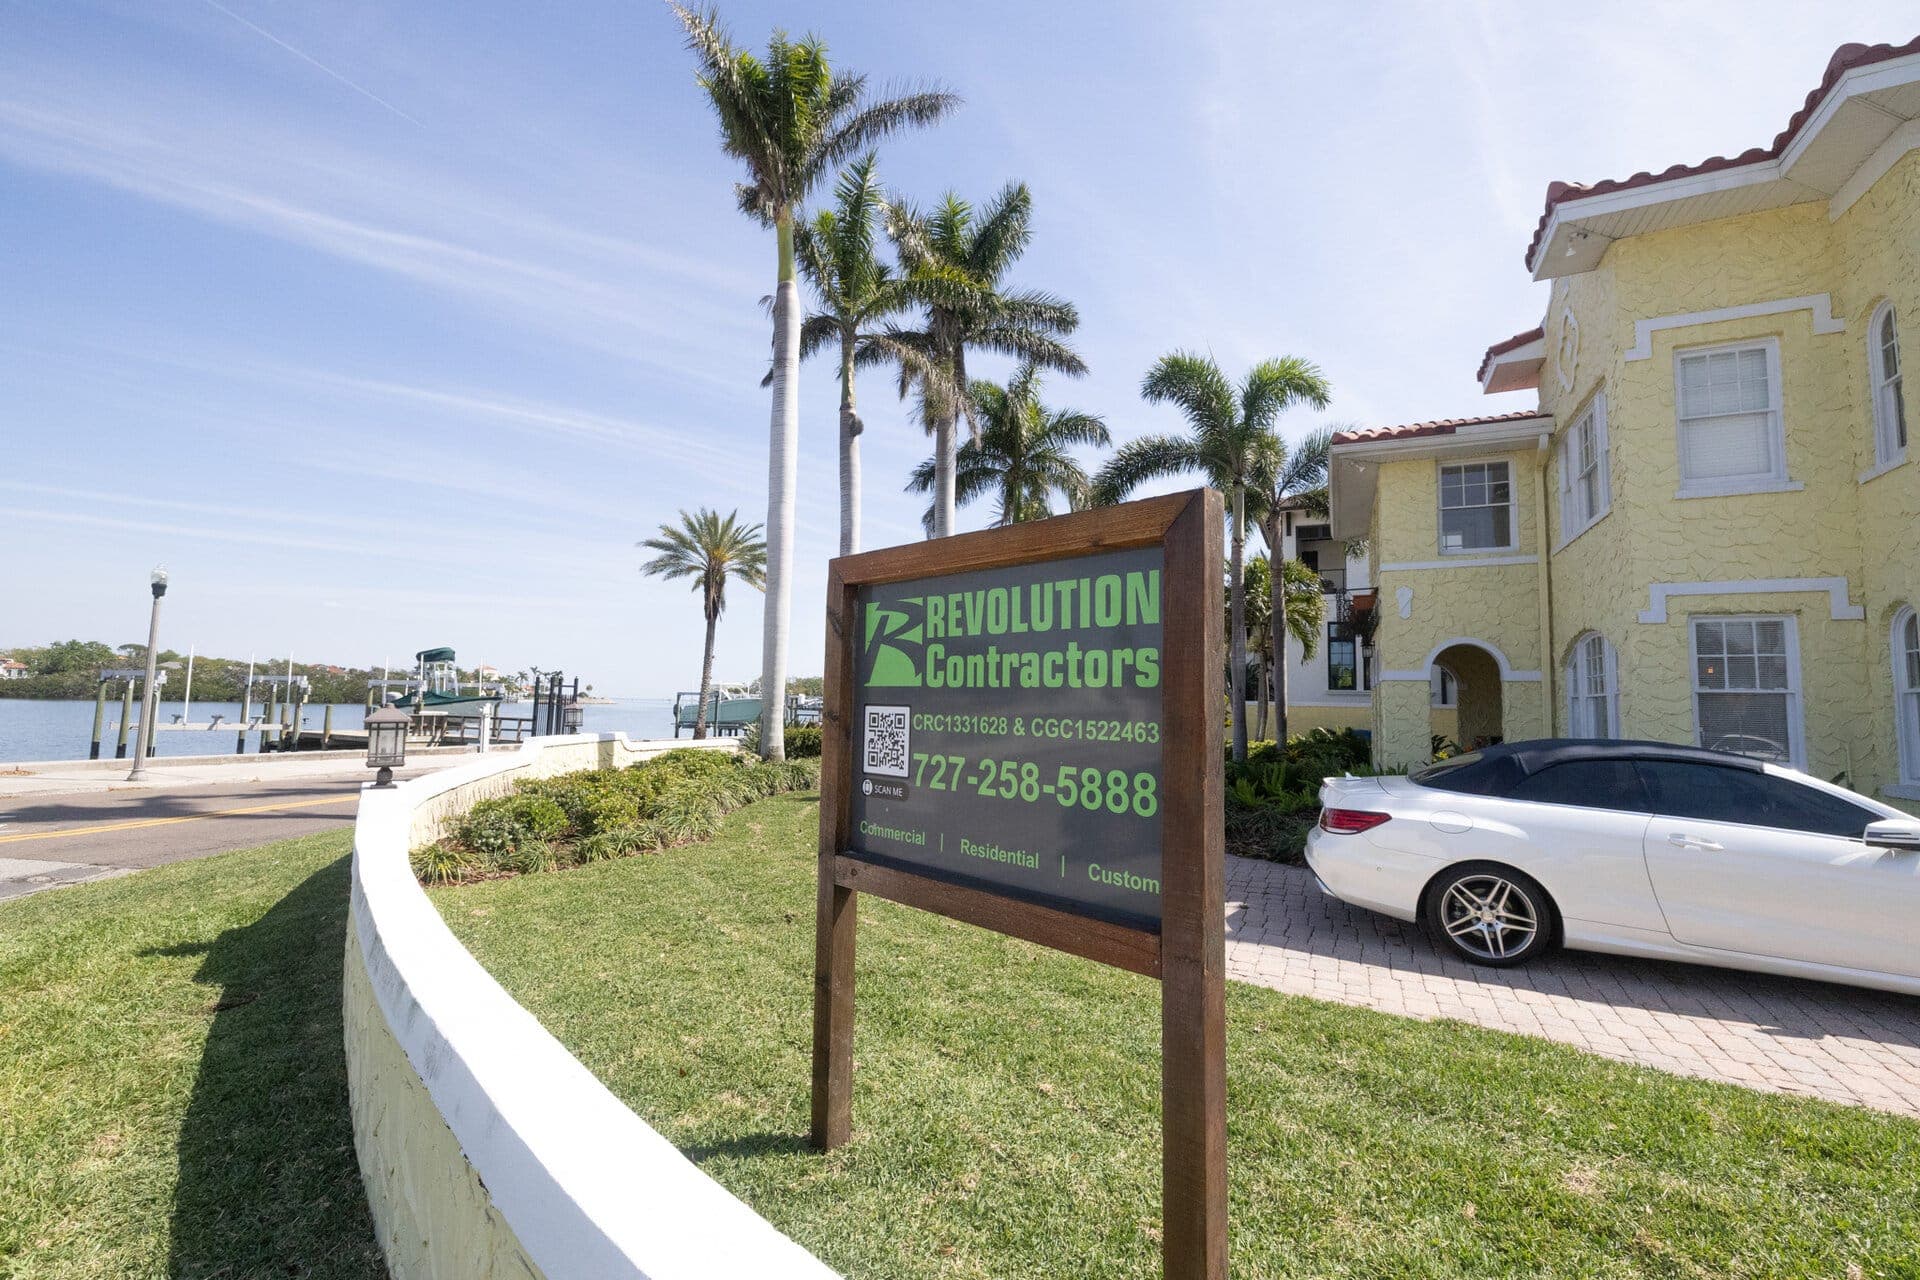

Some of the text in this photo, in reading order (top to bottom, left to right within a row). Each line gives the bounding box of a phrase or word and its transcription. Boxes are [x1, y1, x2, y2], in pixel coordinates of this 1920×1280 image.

[926, 569, 1160, 639] REVOLUTION
[926, 641, 1160, 689] Contractors
[913, 713, 1160, 744] CRC1331628 & CGC1522463
[874, 784, 903, 797] SCAN ME
[912, 753, 1158, 818] 727-258-5888
[860, 820, 1160, 895] Commercial Residential Custom
